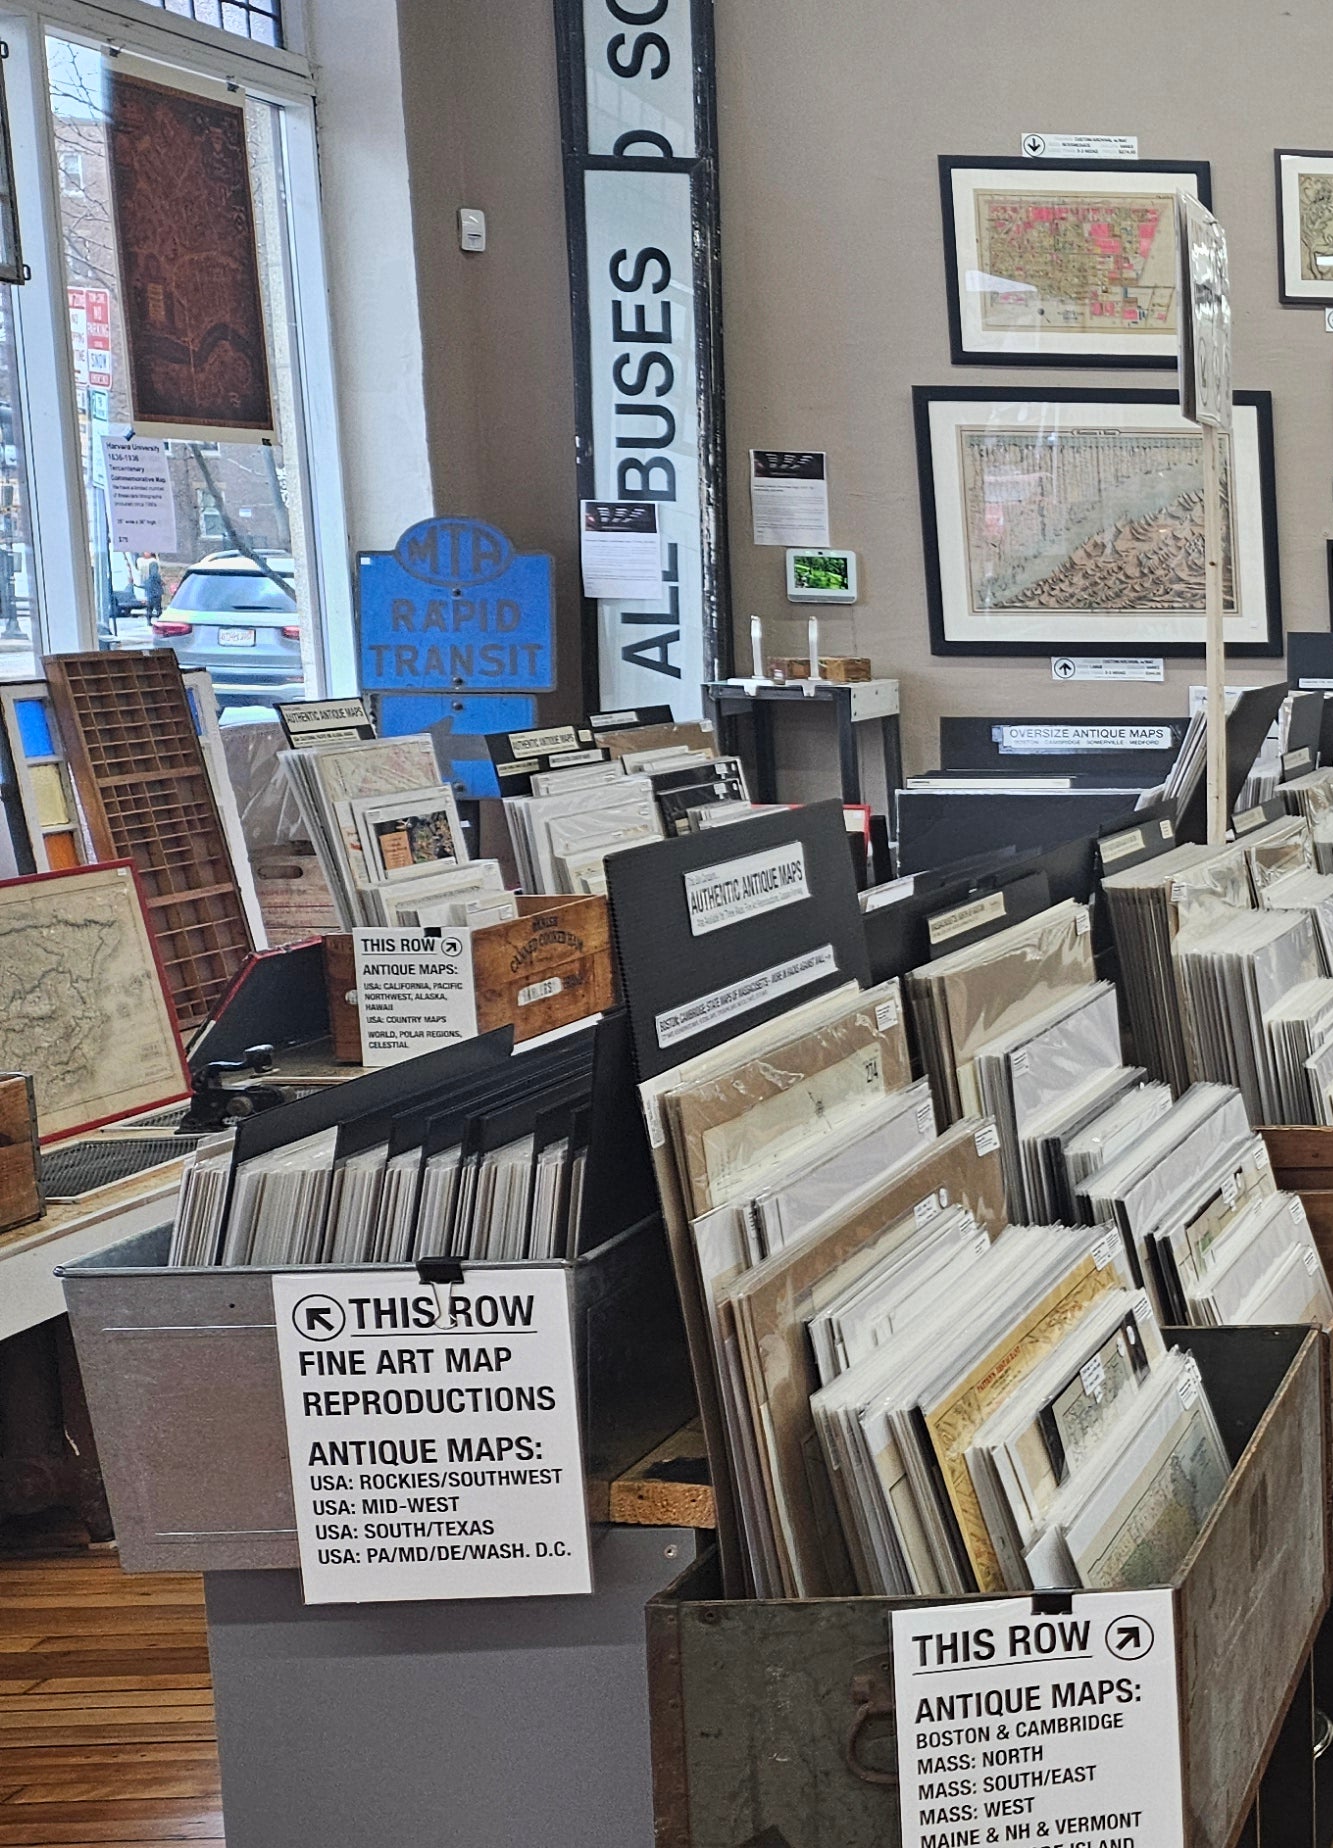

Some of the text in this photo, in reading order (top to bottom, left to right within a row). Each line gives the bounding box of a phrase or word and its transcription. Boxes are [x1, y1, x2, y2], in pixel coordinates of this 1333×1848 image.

[609, 246, 677, 501] BUSES
[408, 526, 501, 575] MTA
[391, 599, 521, 633] RAPID
[369, 644, 543, 677] TRANSIT
[1009, 729, 1164, 739] OVERSIZE ANTIQUE MAPS
[691, 860, 803, 915] AUTHENTIC ANTIQUE MAPS
[361, 938, 436, 952] THIS ROW
[363, 964, 458, 976] ANTIQUE MAPS:
[364, 993, 448, 1001] NORTHWEST, ALASKA,
[433, 982, 463, 990] PACIFIC
[368, 1041, 409, 1049] CELESTIAL
[426, 1030, 462, 1039] REGIONS,
[348, 1295, 534, 1329] THIS ROW
[299, 1347, 512, 1376] FINE ART MAP
[303, 1386, 556, 1416] REPRODUCTIONS
[308, 1436, 542, 1467] ANTIQUE MAPS:
[311, 1469, 563, 1490] USA: ROCKIES/SOUTHWEST
[313, 1497, 459, 1515] USA: MID-WEST
[316, 1520, 494, 1540] USA: SOUTH/TEXAS
[318, 1542, 571, 1564] USA: PA/MD/DE/WASH. D.C.
[912, 1621, 1090, 1666] THIS ROW
[915, 1678, 1141, 1724] ANTIQUE MAPS:
[916, 1713, 1123, 1749] BOSTON & CAMBRIDGE
[918, 1746, 1043, 1775] MASS: NORTH
[918, 1765, 1096, 1800] MASS: SOUTH/EAST
[919, 1797, 1034, 1825] MASS: WEST
[920, 1811, 1142, 1848] MAINE & NH & VERMONT
